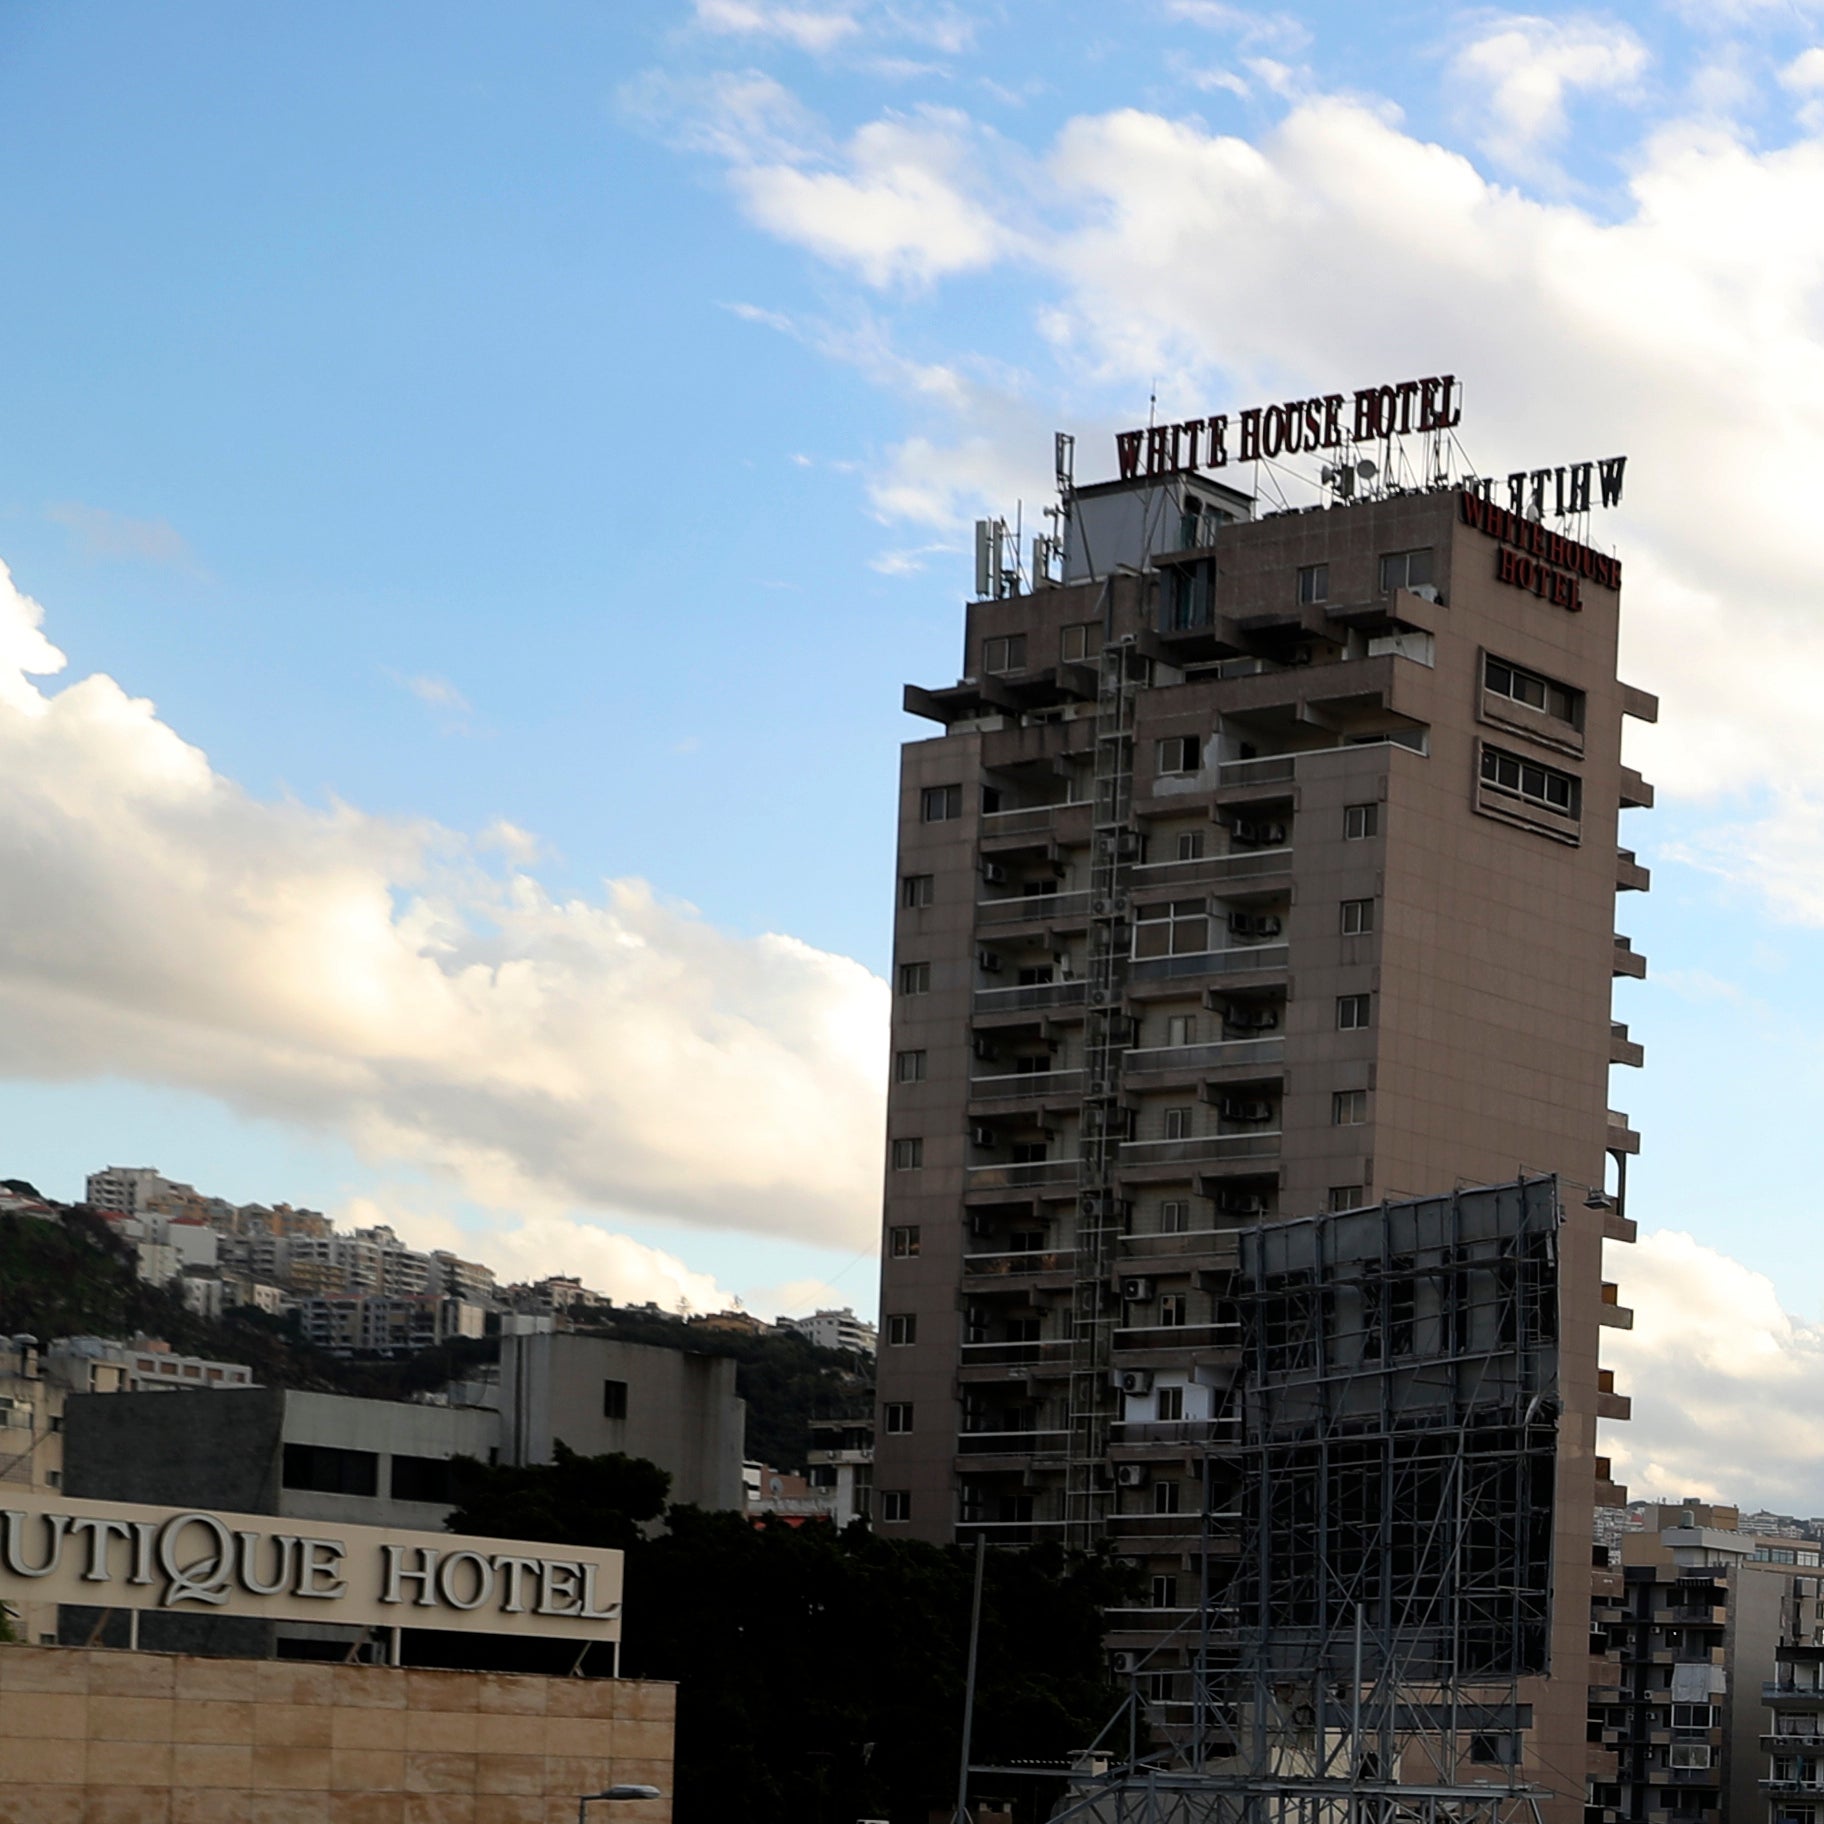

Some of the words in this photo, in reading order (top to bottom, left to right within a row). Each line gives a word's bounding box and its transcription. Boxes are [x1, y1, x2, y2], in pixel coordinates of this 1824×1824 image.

[1115, 415, 1228, 481] WHITE
[1239, 394, 1345, 461] HOUSE
[1352, 375, 1461, 442] HOTEL
[1461, 490, 1546, 556] WHITE
[1547, 530, 1622, 591] HOUSE
[1497, 547, 1583, 612] HOTEL
[381, 1544, 621, 1620] HOTEL
